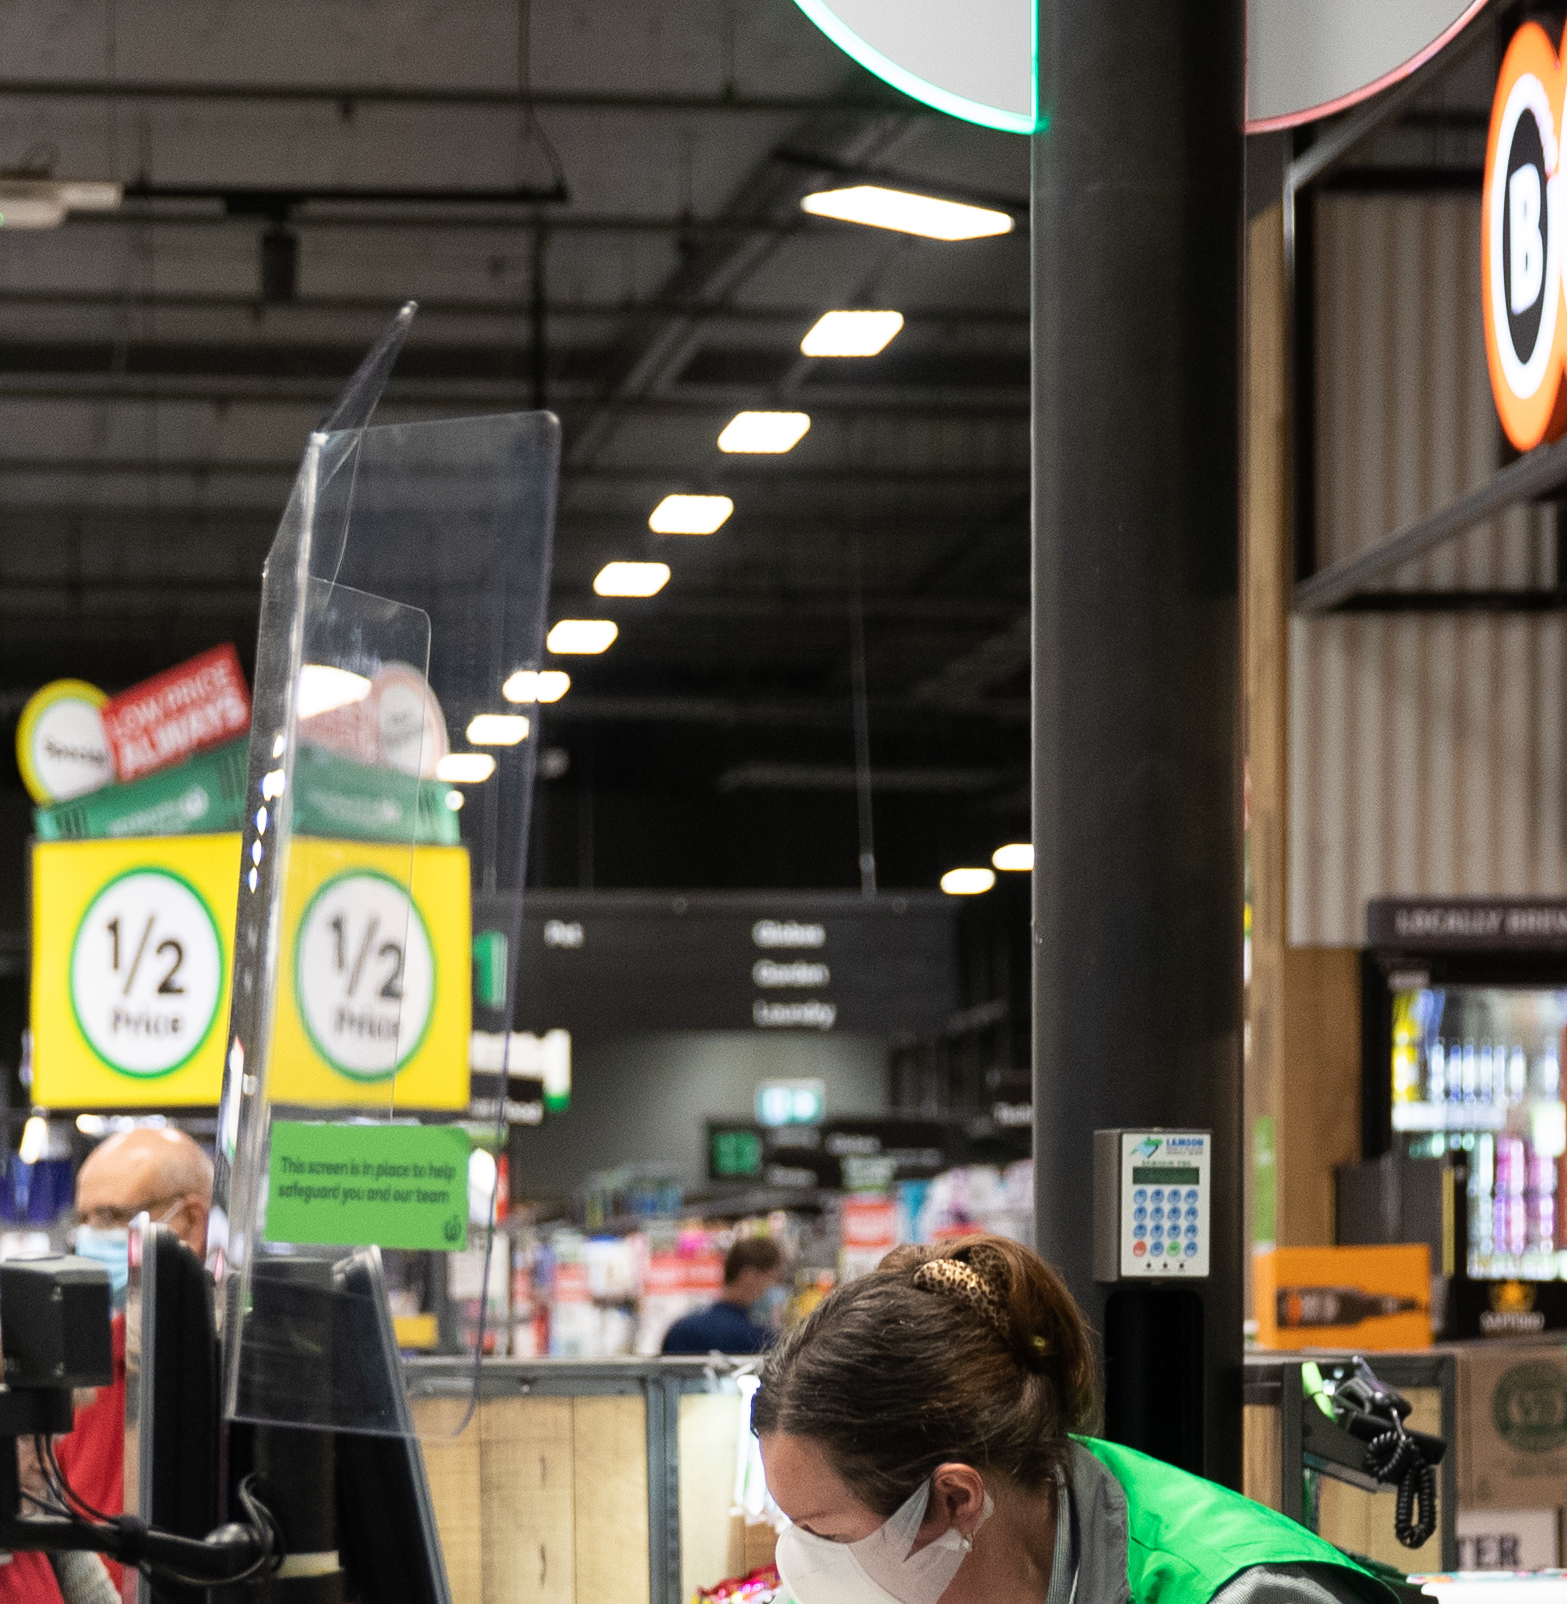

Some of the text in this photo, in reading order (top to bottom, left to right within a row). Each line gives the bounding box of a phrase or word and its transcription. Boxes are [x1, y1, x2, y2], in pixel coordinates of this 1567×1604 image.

[1395, 908, 1505, 936] LOCALLY
[104, 912, 187, 998] 1/2
[329, 912, 406, 1000] 1/2
[109, 1007, 185, 1040] Price
[332, 1007, 401, 1041] Price
[280, 1155, 457, 1184] This screen is in place to help
[278, 1181, 449, 1205] safeguard you and our team
